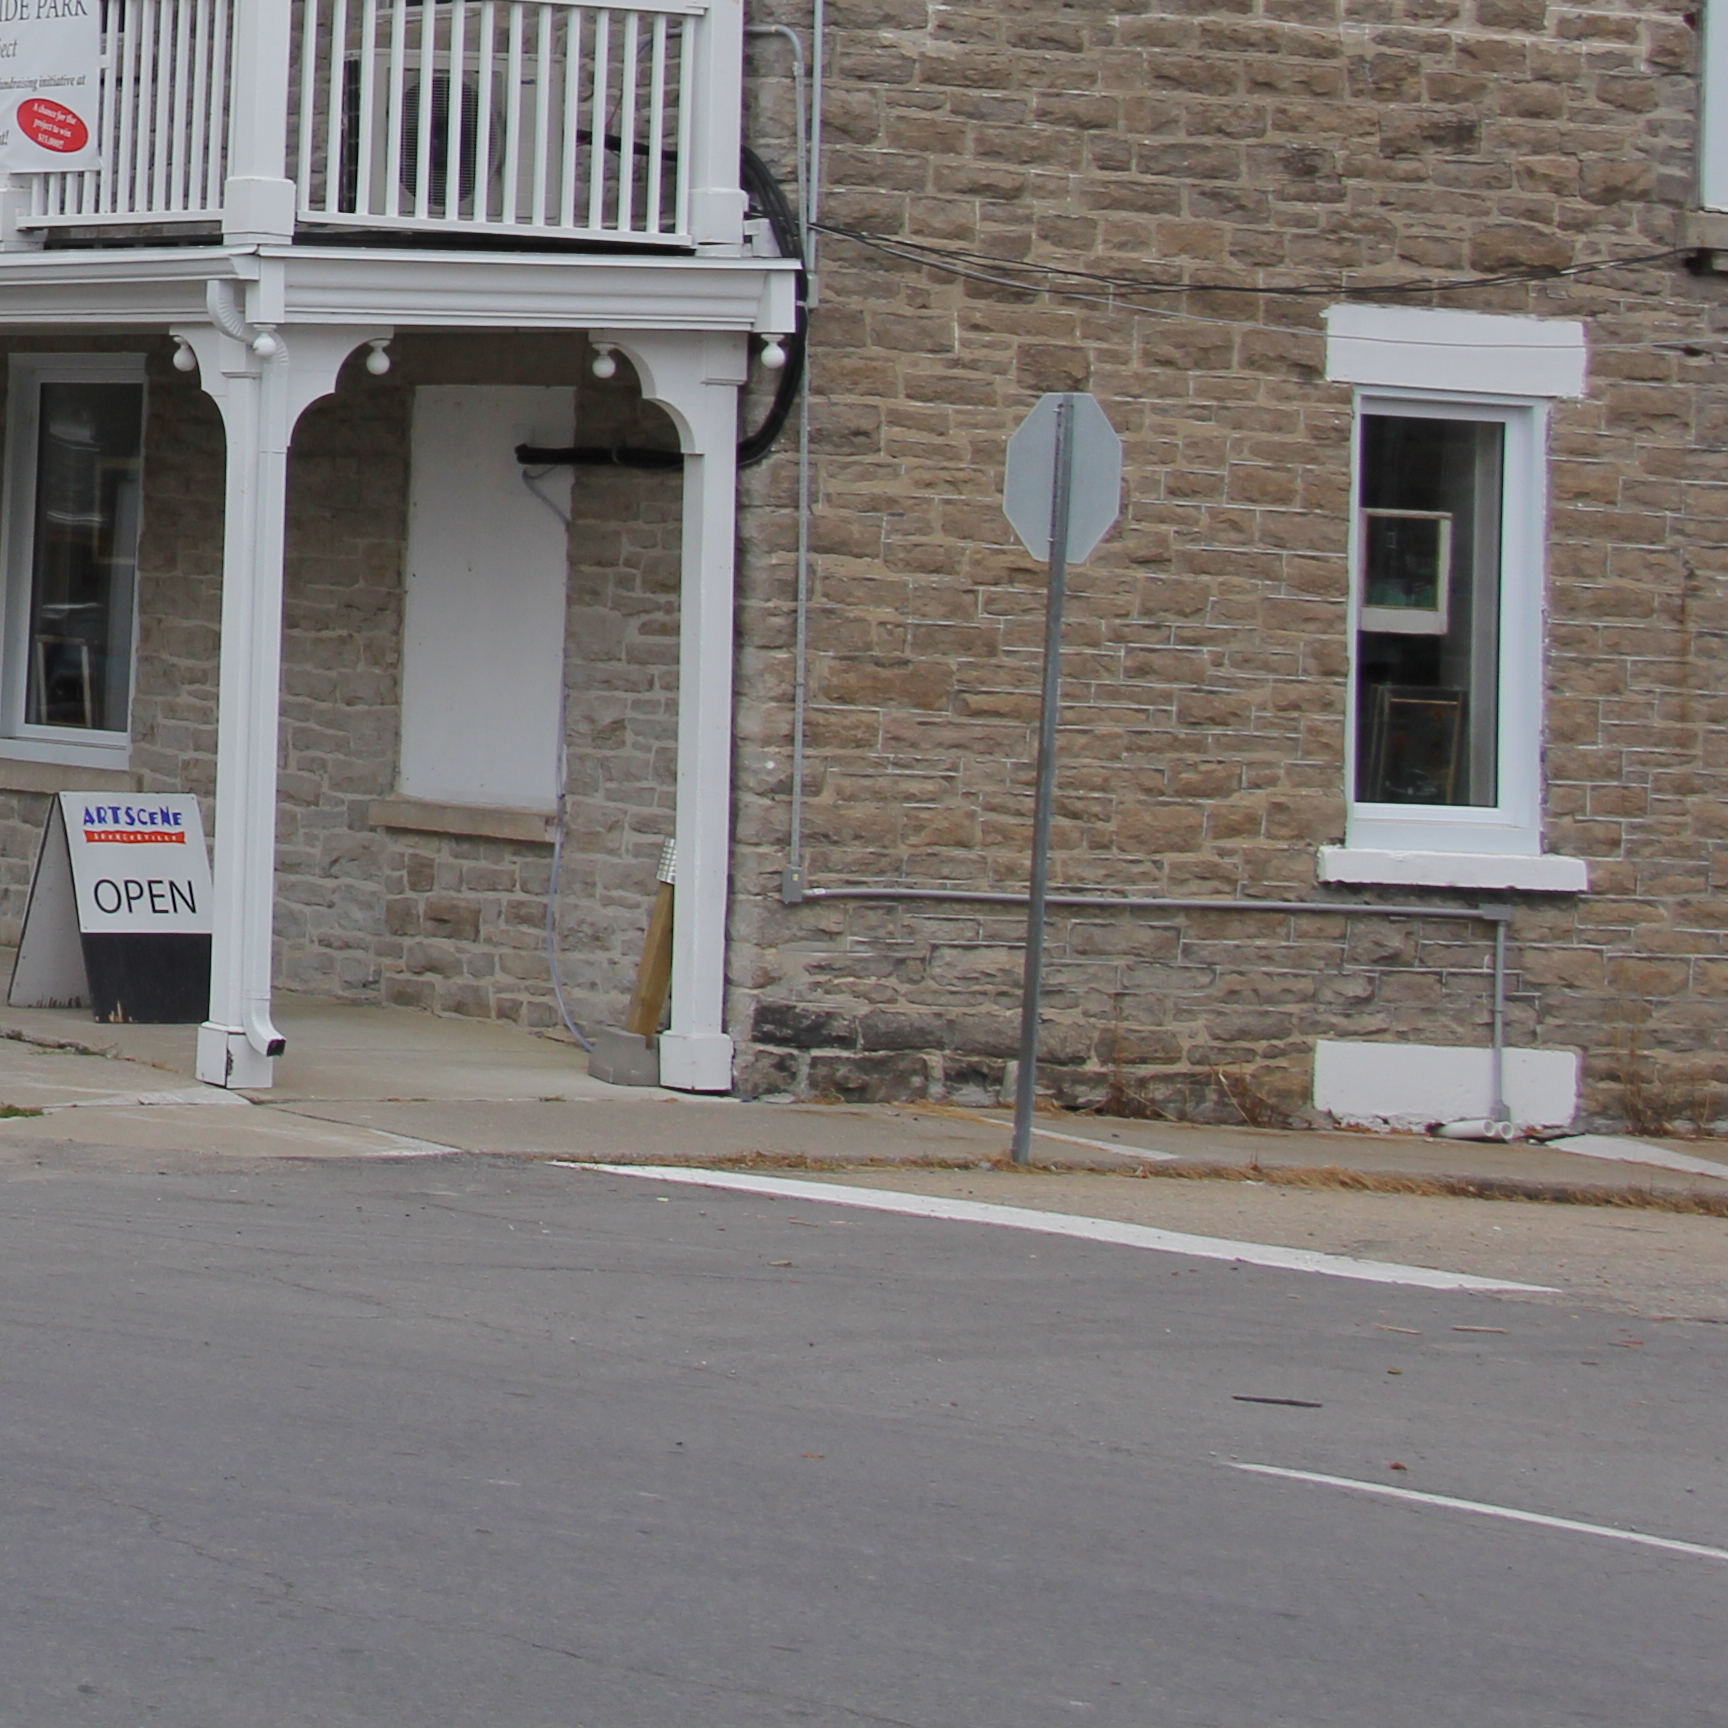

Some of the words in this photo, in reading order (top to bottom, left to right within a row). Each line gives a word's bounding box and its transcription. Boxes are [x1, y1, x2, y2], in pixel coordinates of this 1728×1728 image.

[39, 75, 75, 88] initiative
[76, 74, 86, 86] at
[94, 879, 197, 915] OPEN
